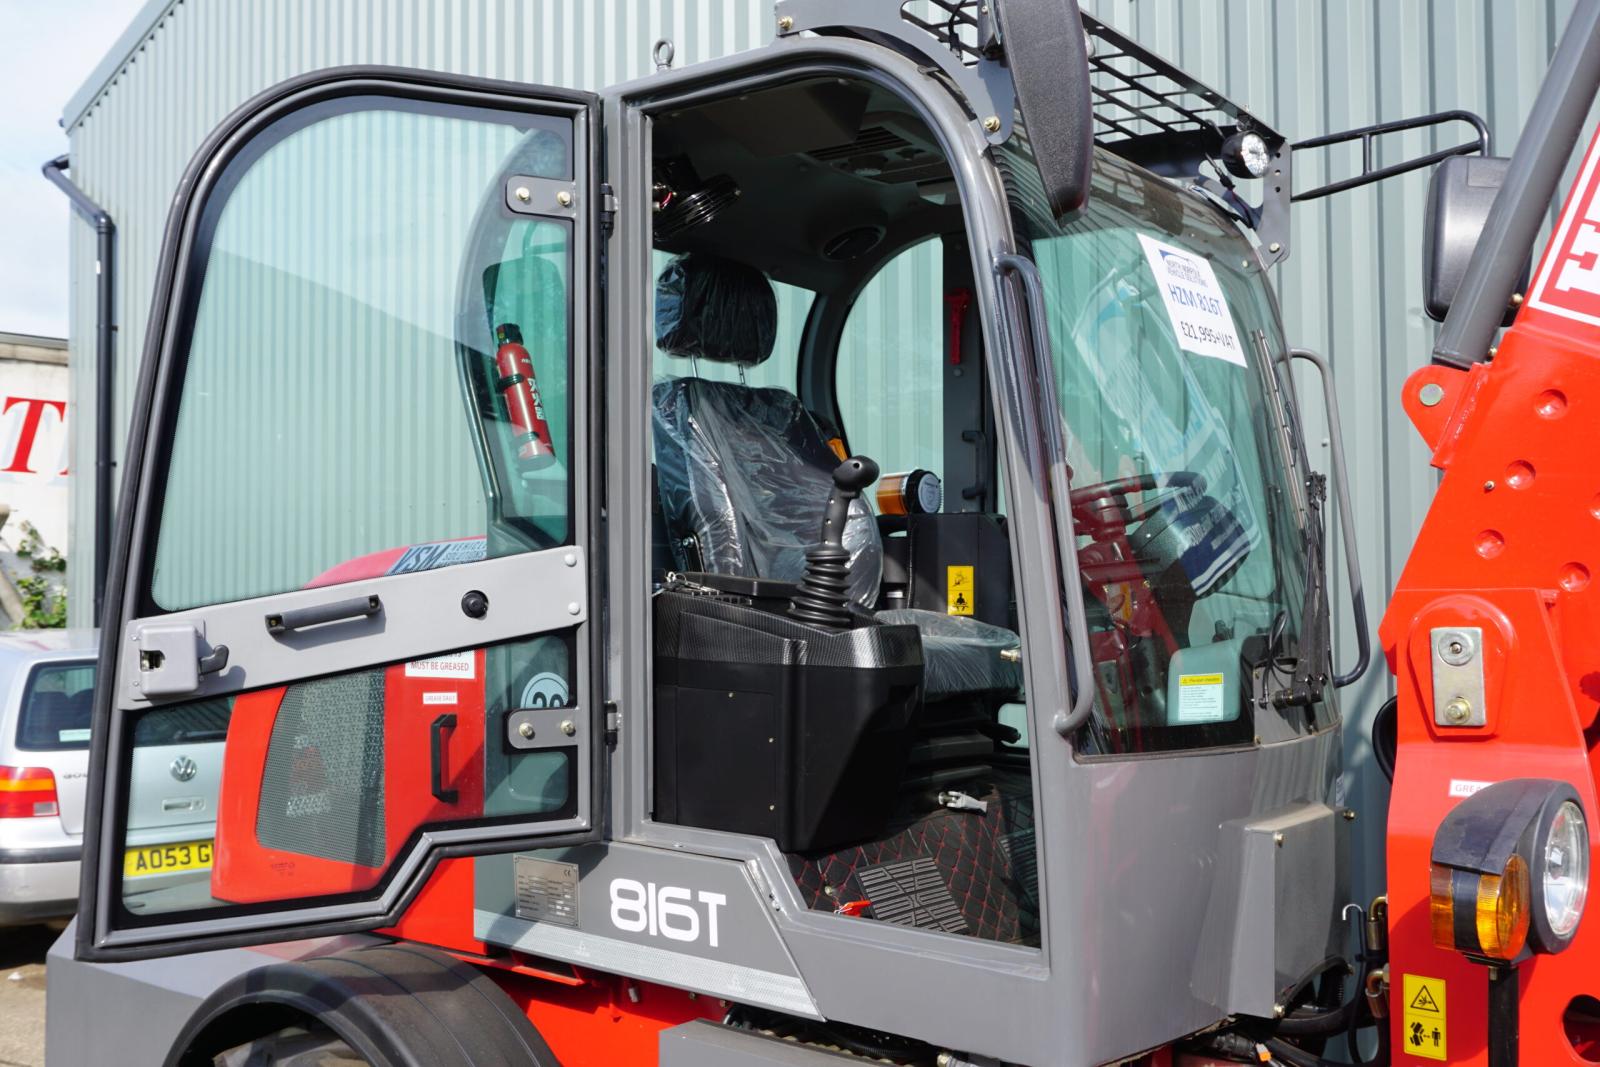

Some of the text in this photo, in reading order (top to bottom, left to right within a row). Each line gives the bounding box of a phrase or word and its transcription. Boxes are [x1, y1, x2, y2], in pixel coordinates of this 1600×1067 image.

[1168, 283, 1223, 317] HZM 816T
[391, 544, 451, 574] VSM
[410, 661, 469, 671] MUST BE GREASED
[609, 877, 727, 948] 816T
